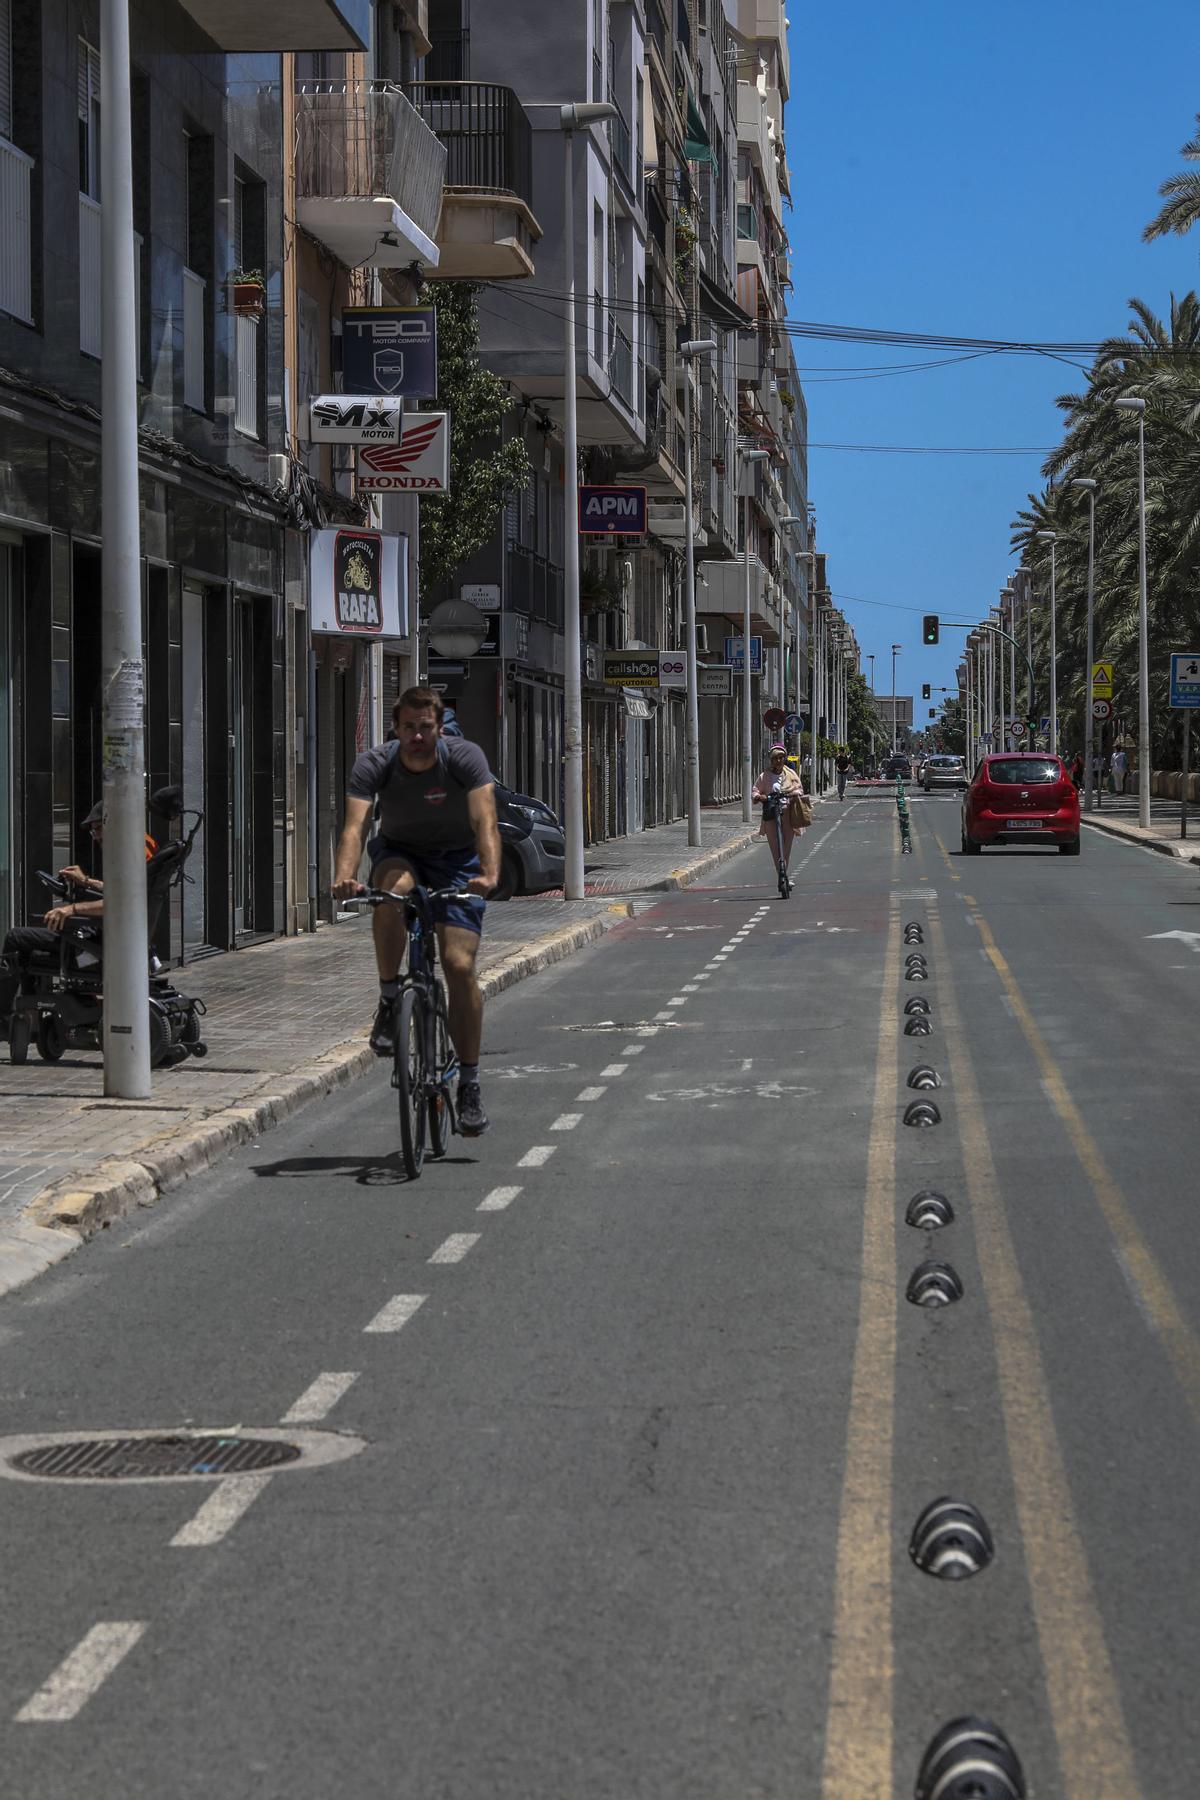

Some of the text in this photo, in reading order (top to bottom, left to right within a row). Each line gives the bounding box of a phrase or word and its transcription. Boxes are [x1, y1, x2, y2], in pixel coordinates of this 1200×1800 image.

[361, 430, 395, 439] MOTOR
[358, 476, 443, 489] HONDA
[586, 496, 638, 516] APM
[338, 592, 379, 624] RAFA
[607, 663, 658, 677] callshop
[1094, 705, 1108, 713] 30
